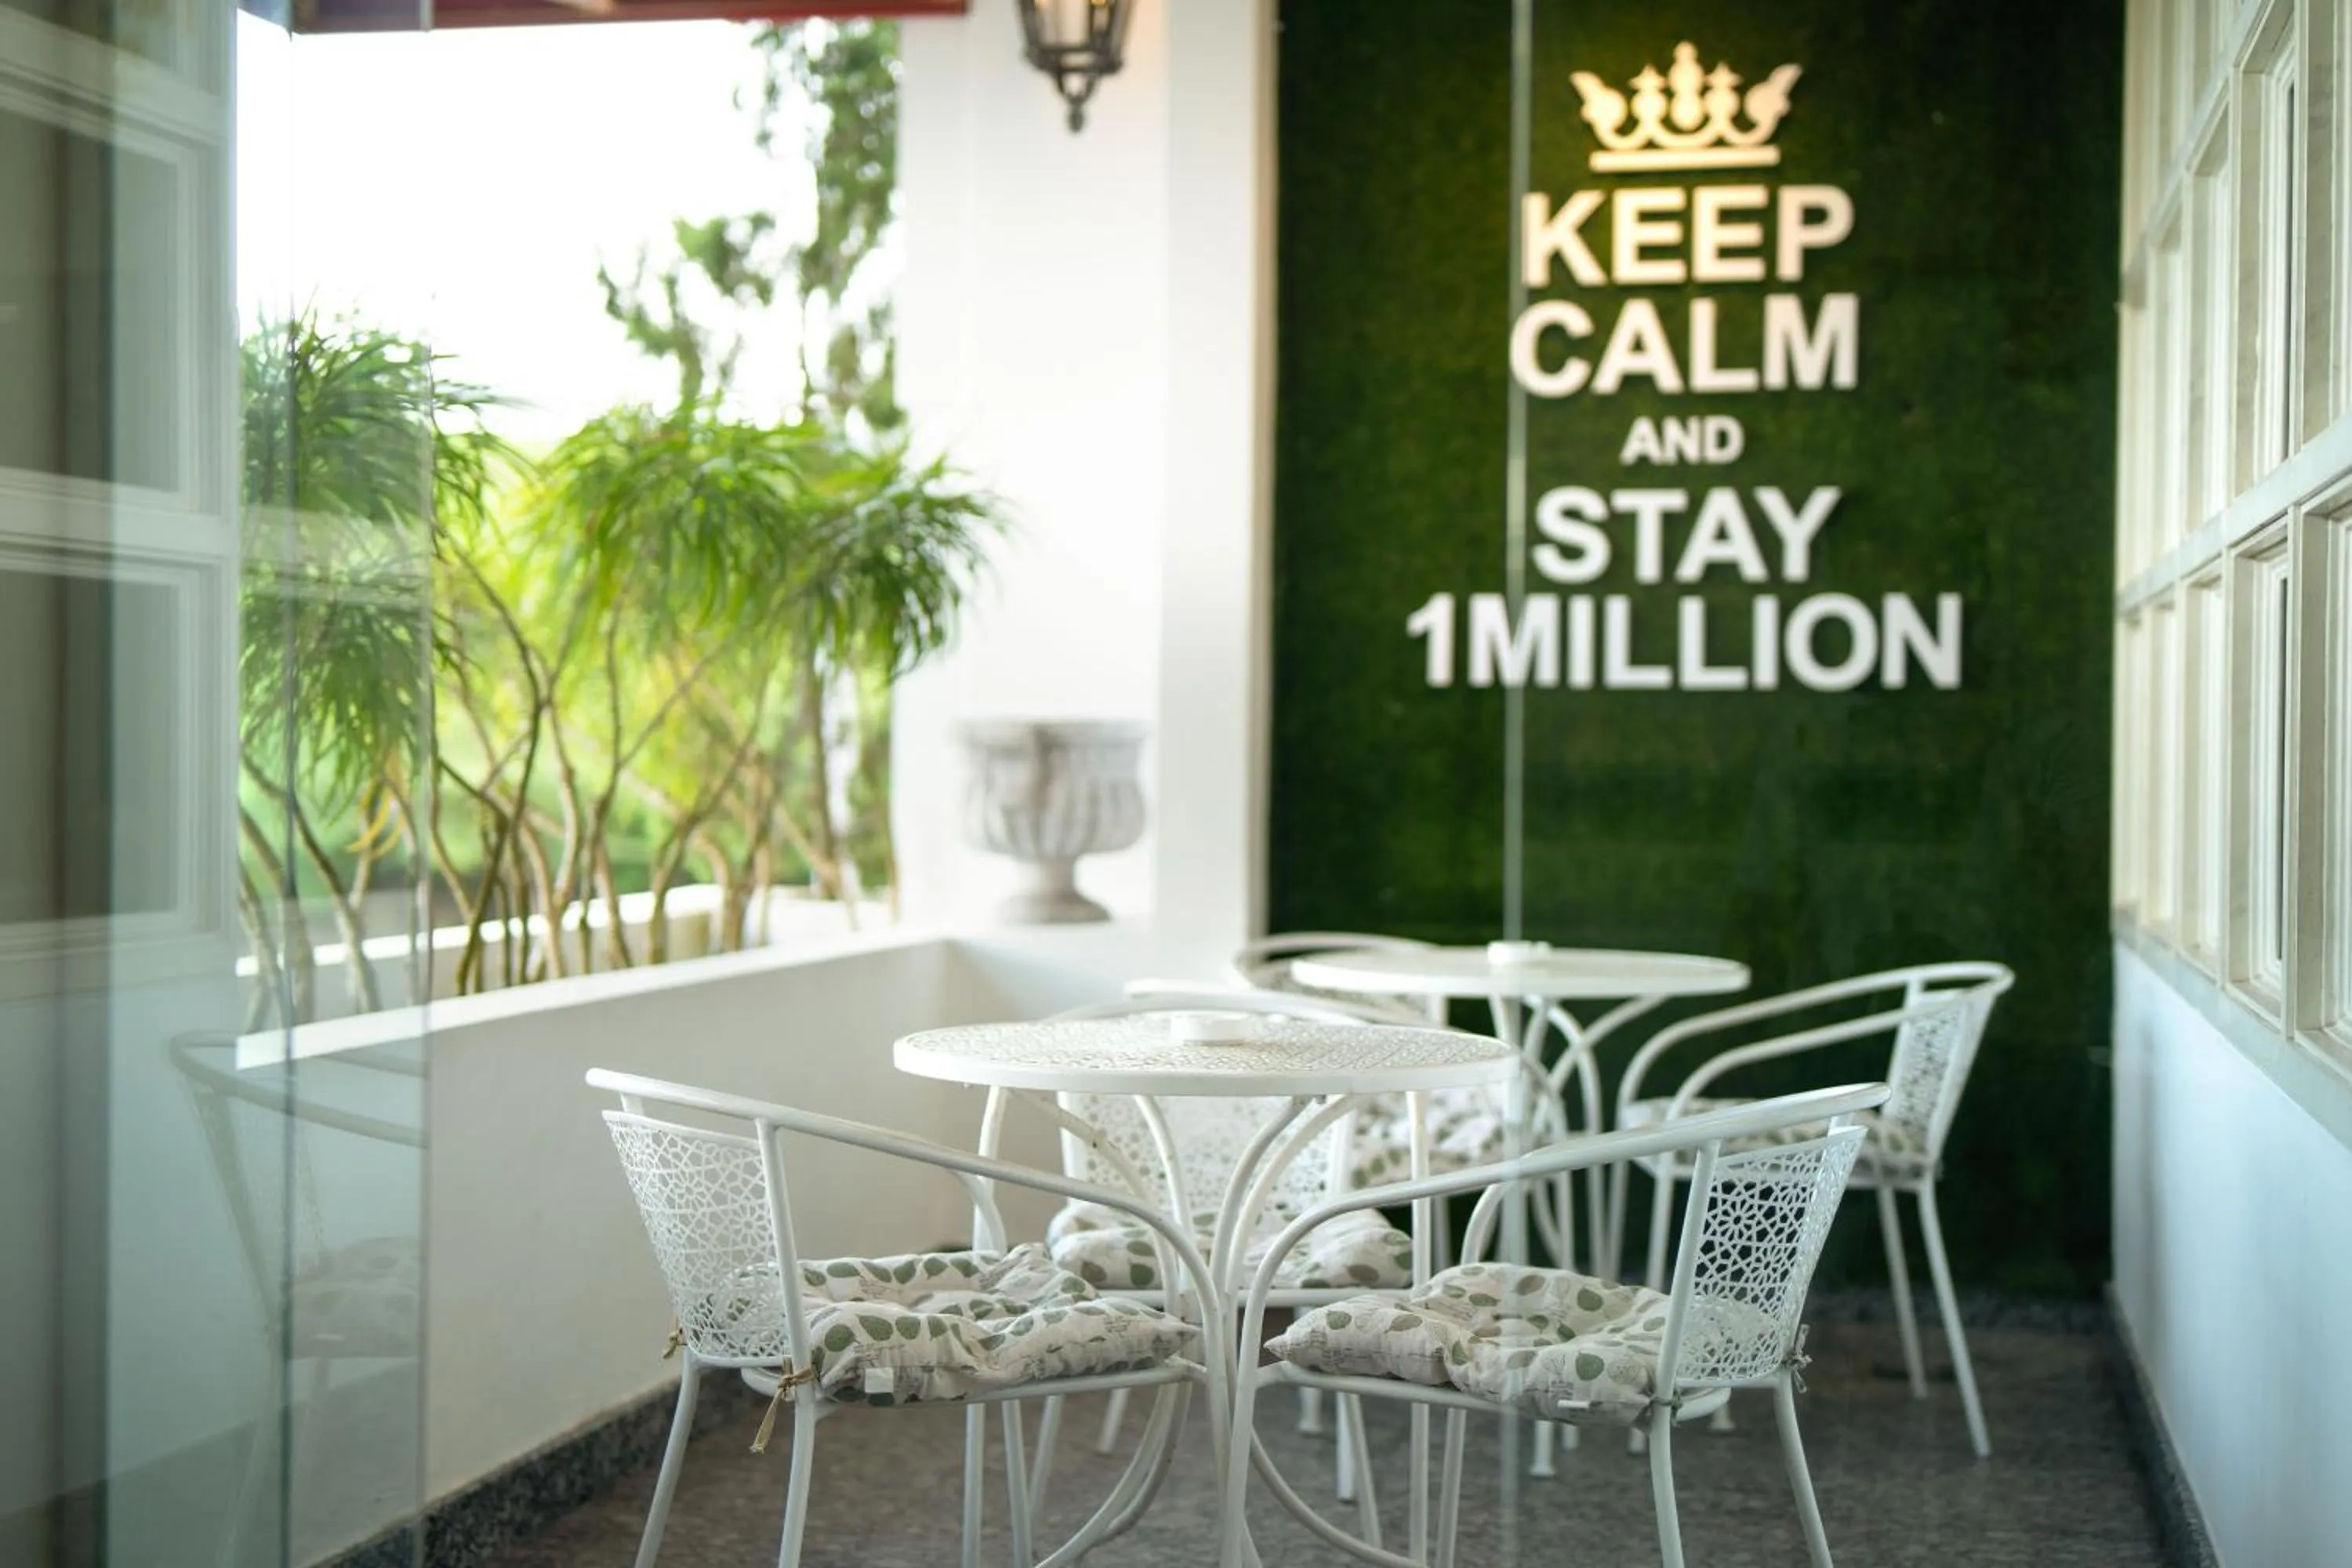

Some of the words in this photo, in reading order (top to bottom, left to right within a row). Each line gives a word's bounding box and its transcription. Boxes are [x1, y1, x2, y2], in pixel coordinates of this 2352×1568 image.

[1522, 184, 1854, 287] KEEP
[1509, 292, 1859, 397] CALM
[1621, 416, 1744, 465] AND
[1533, 486, 1841, 583] STAY
[1406, 592, 1962, 691] 1MILLION
